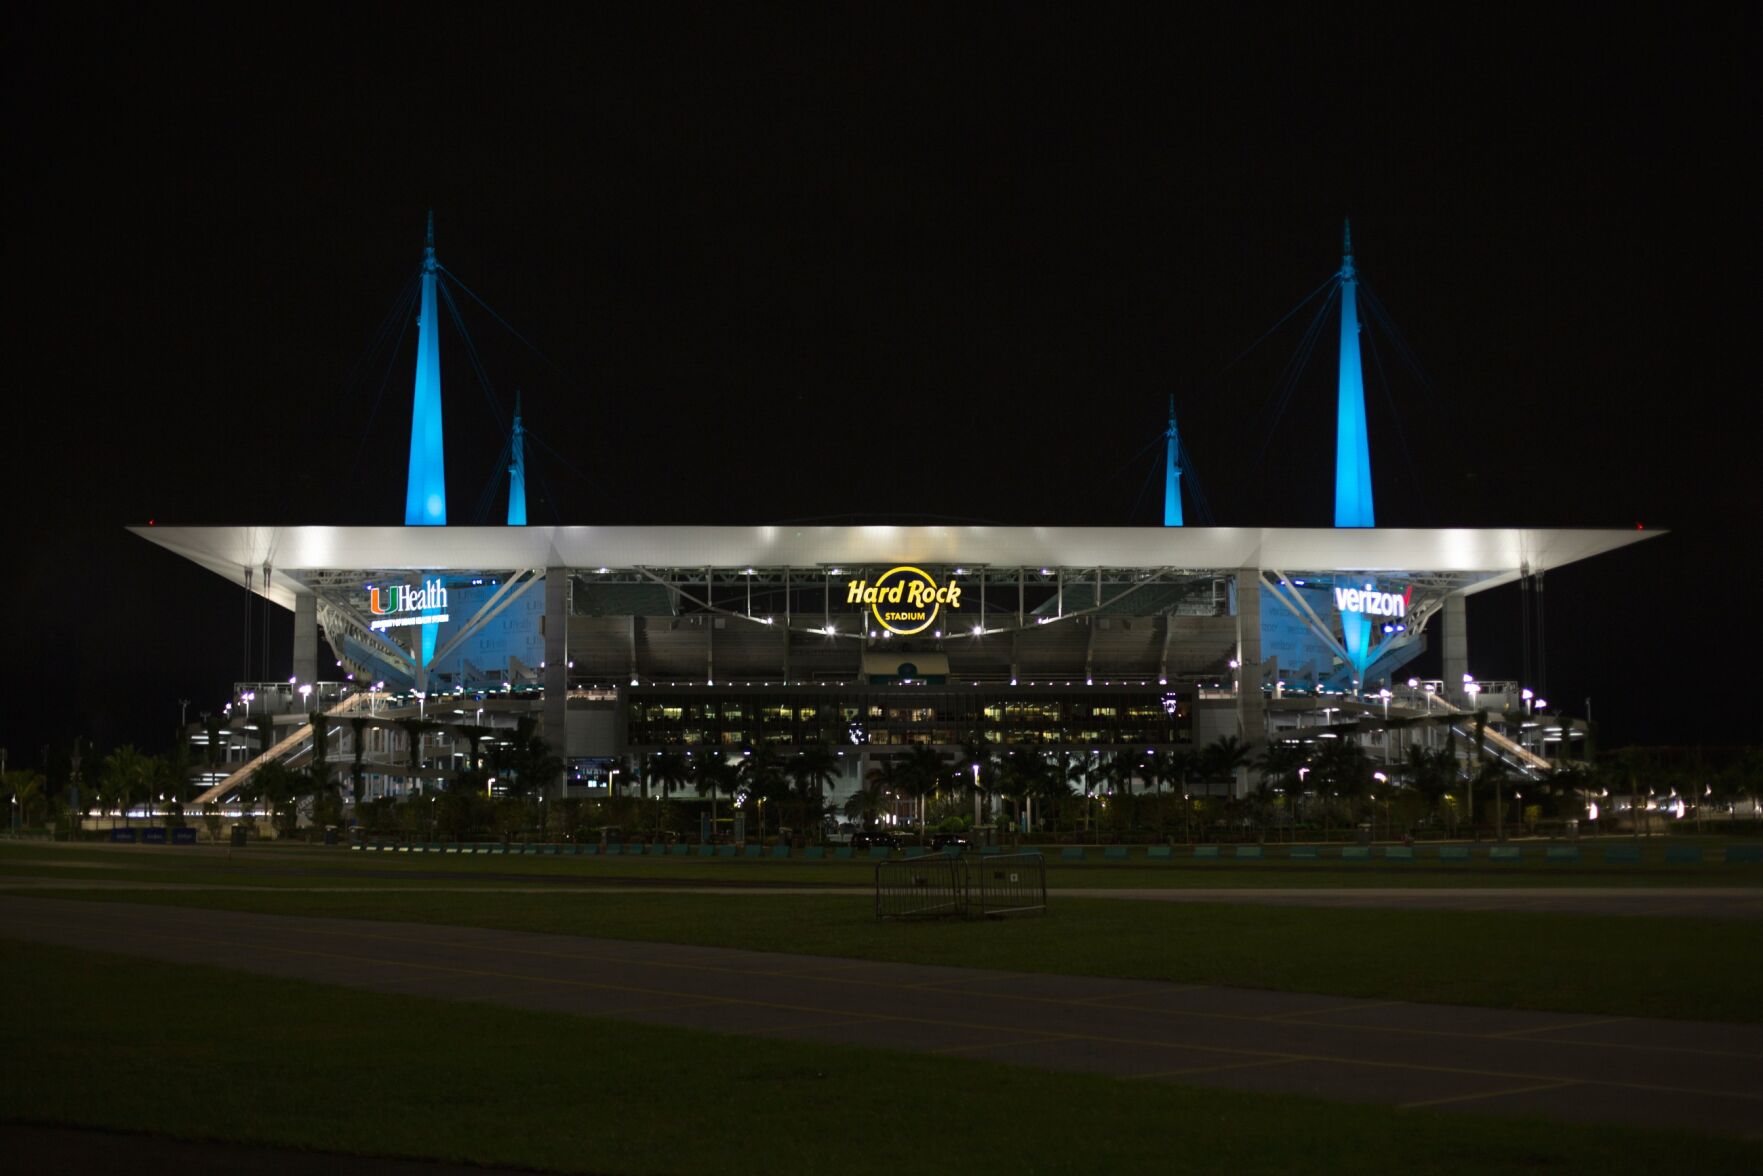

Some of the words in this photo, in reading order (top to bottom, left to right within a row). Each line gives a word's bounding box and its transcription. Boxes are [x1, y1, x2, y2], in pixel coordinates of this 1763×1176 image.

[370, 578, 448, 615] UHealth
[847, 580, 905, 604] Hard
[907, 580, 961, 608] Rock
[1335, 583, 1405, 617] verizon
[885, 612, 925, 621] STADIUM
